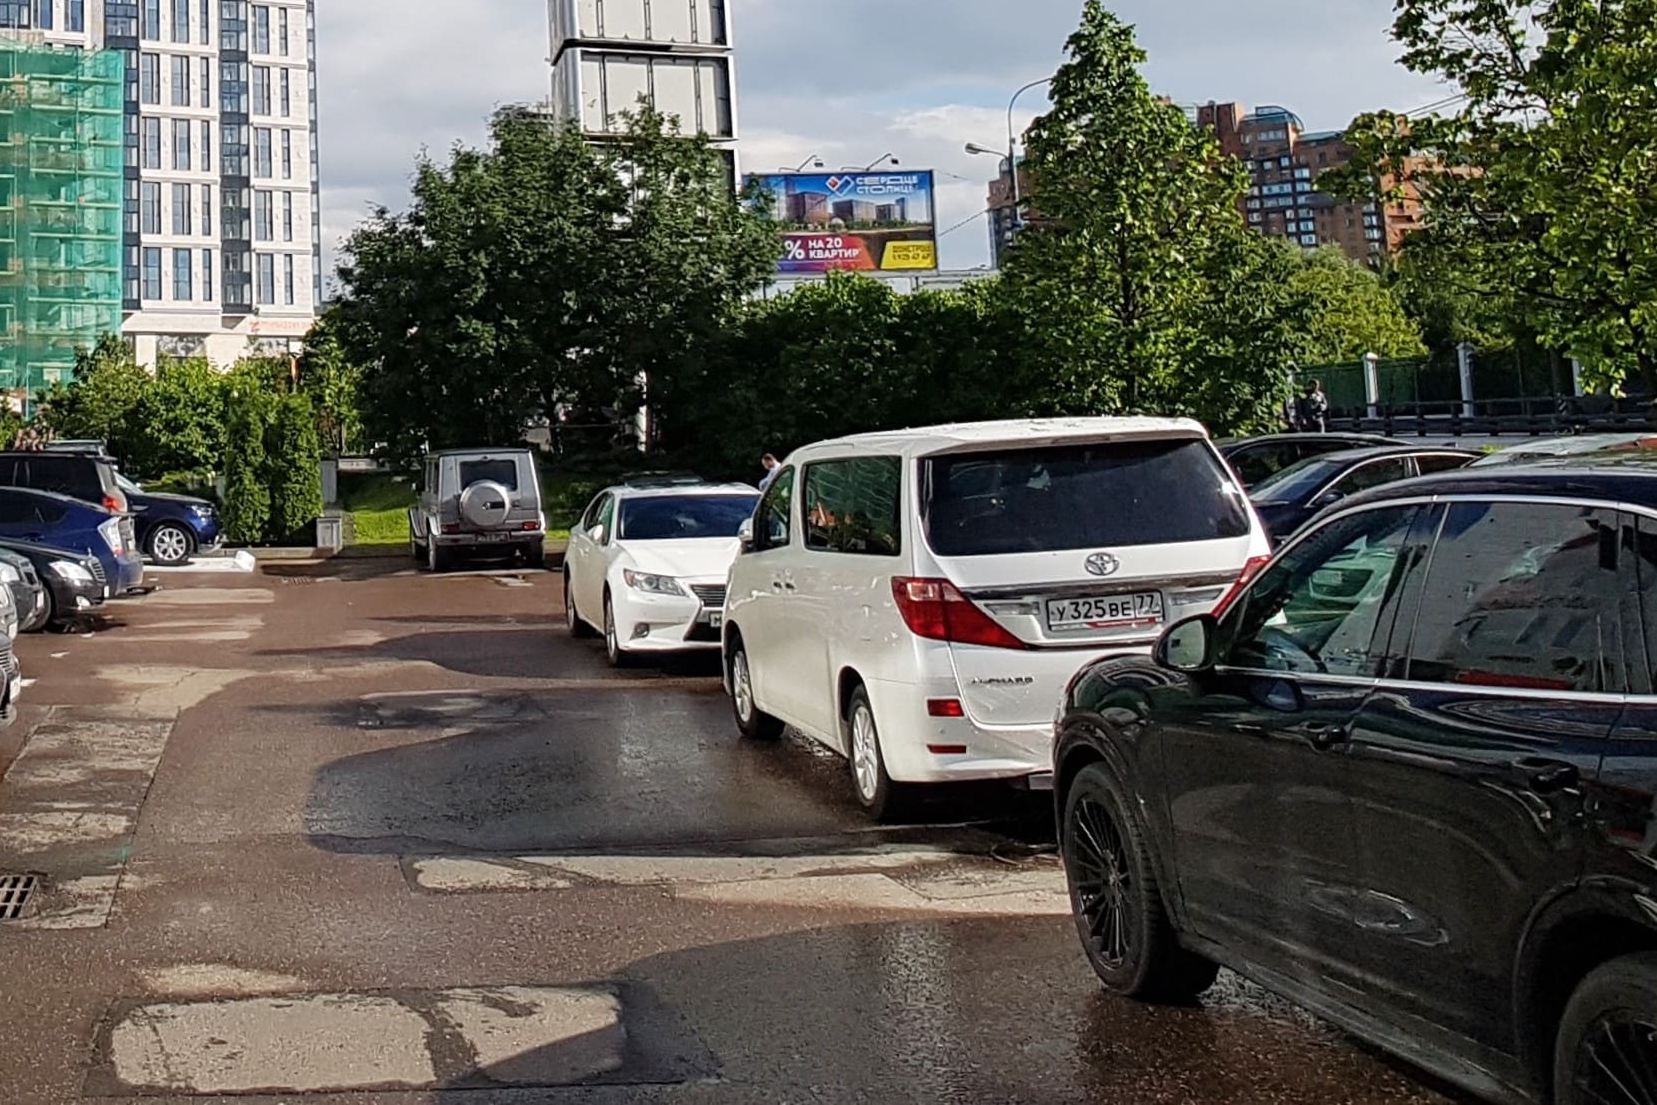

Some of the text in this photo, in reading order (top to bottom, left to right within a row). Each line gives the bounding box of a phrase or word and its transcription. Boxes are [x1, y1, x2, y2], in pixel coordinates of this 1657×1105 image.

[808, 237, 843, 249] НА 20
[809, 249, 859, 259] КВАРТИР
